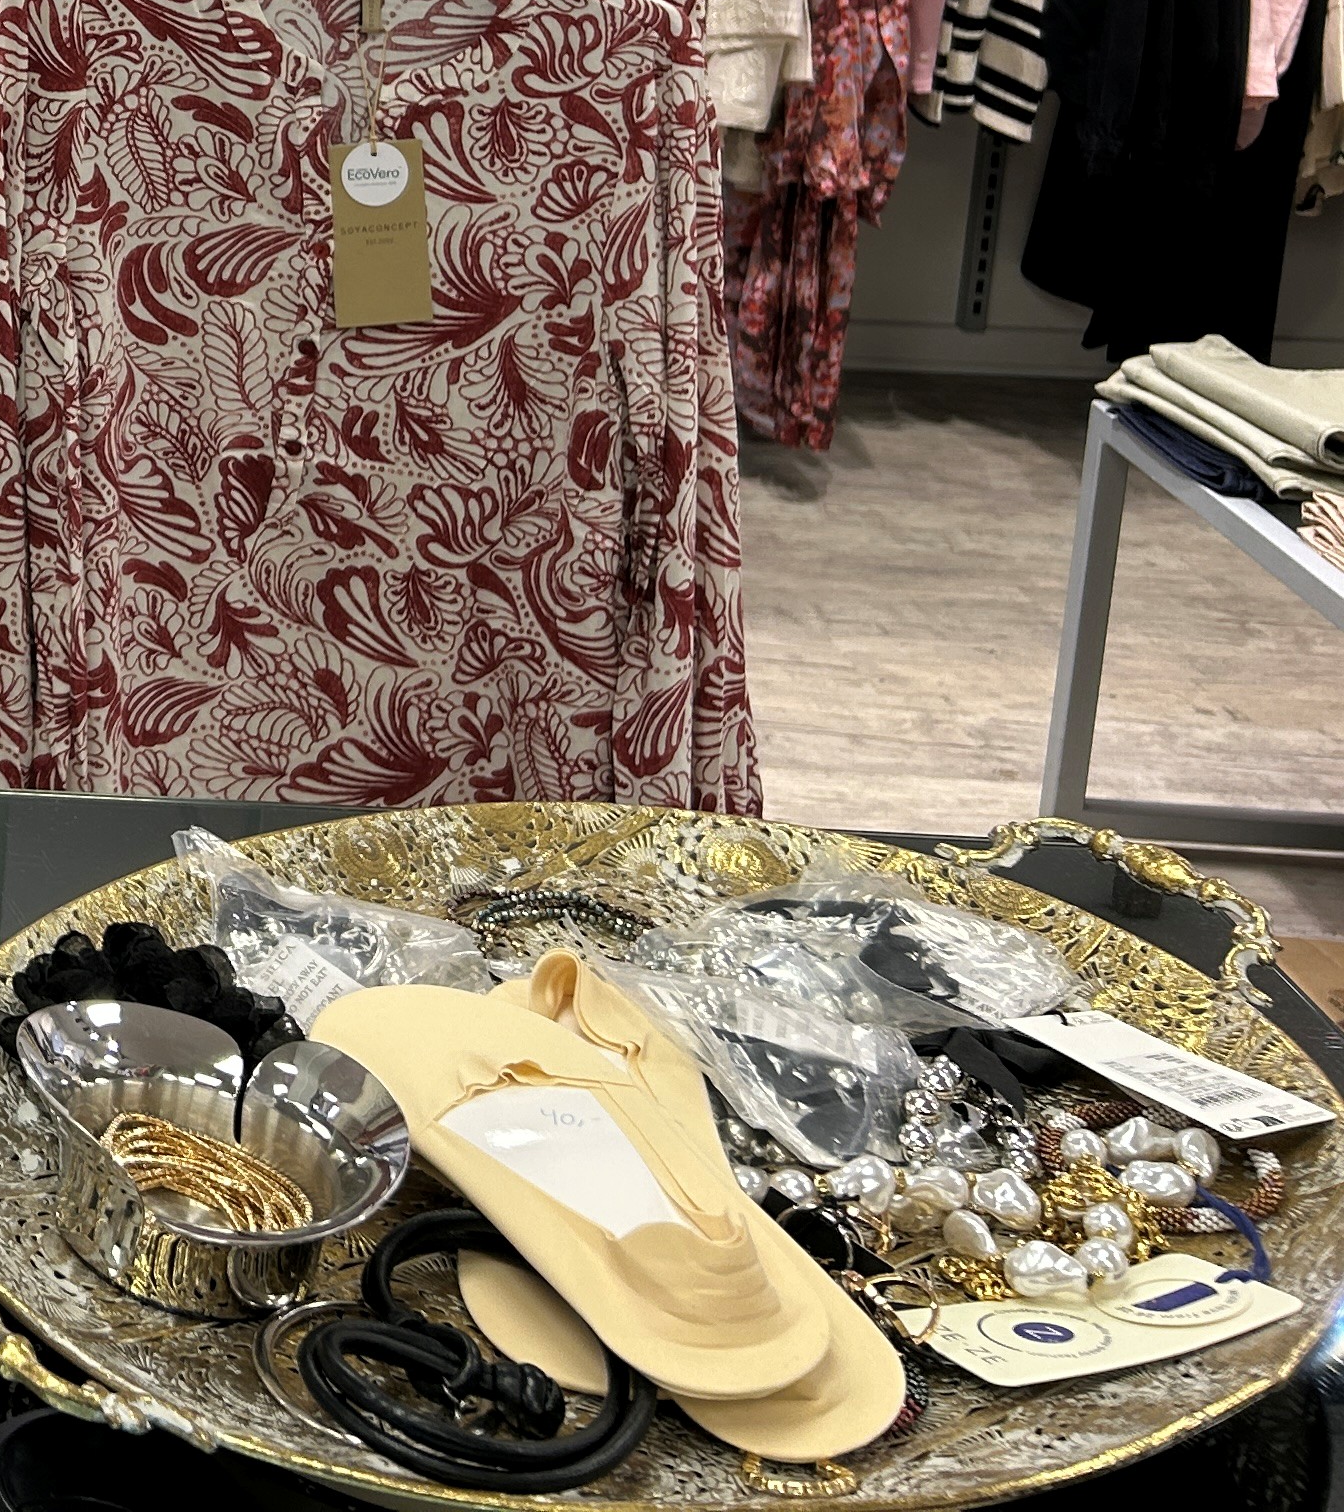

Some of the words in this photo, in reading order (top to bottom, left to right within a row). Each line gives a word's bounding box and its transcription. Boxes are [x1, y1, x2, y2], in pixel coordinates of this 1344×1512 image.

[260, 945, 296, 981] SILICA
[297, 959, 319, 984] AWAY
[267, 978, 285, 995] EL
[295, 985, 313, 1004] NOT
